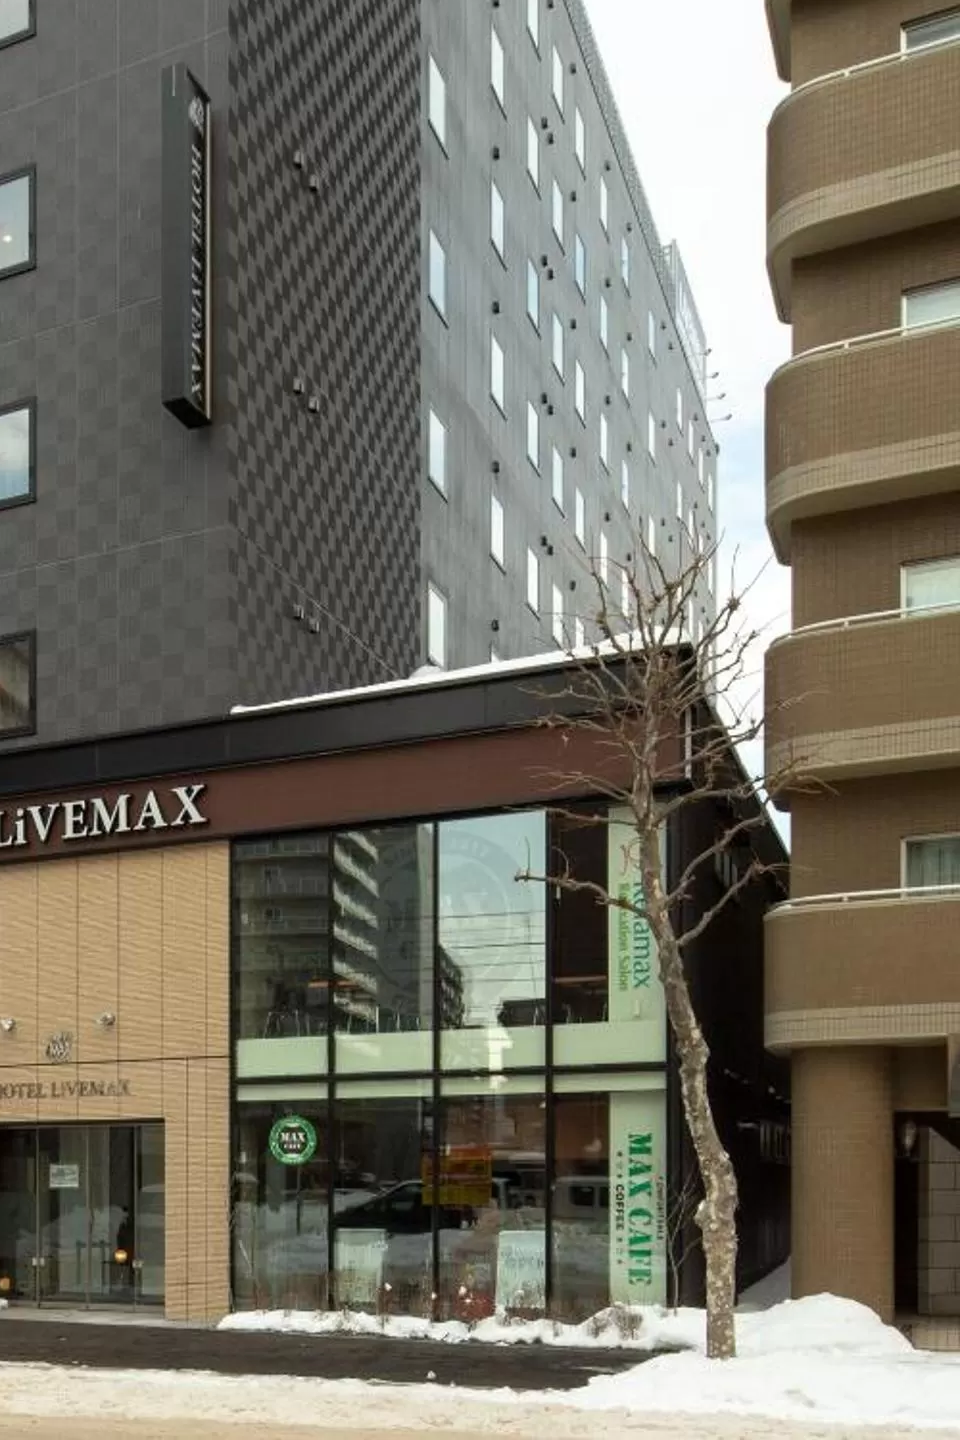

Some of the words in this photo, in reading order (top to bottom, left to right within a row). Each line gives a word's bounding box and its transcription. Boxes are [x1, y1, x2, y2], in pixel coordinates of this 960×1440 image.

[280, 1131, 306, 1143] MAX
[628, 1132, 653, 1198] MAX
[615, 1183, 625, 1231] COFFEE
[628, 1206, 654, 1286] CAFE
